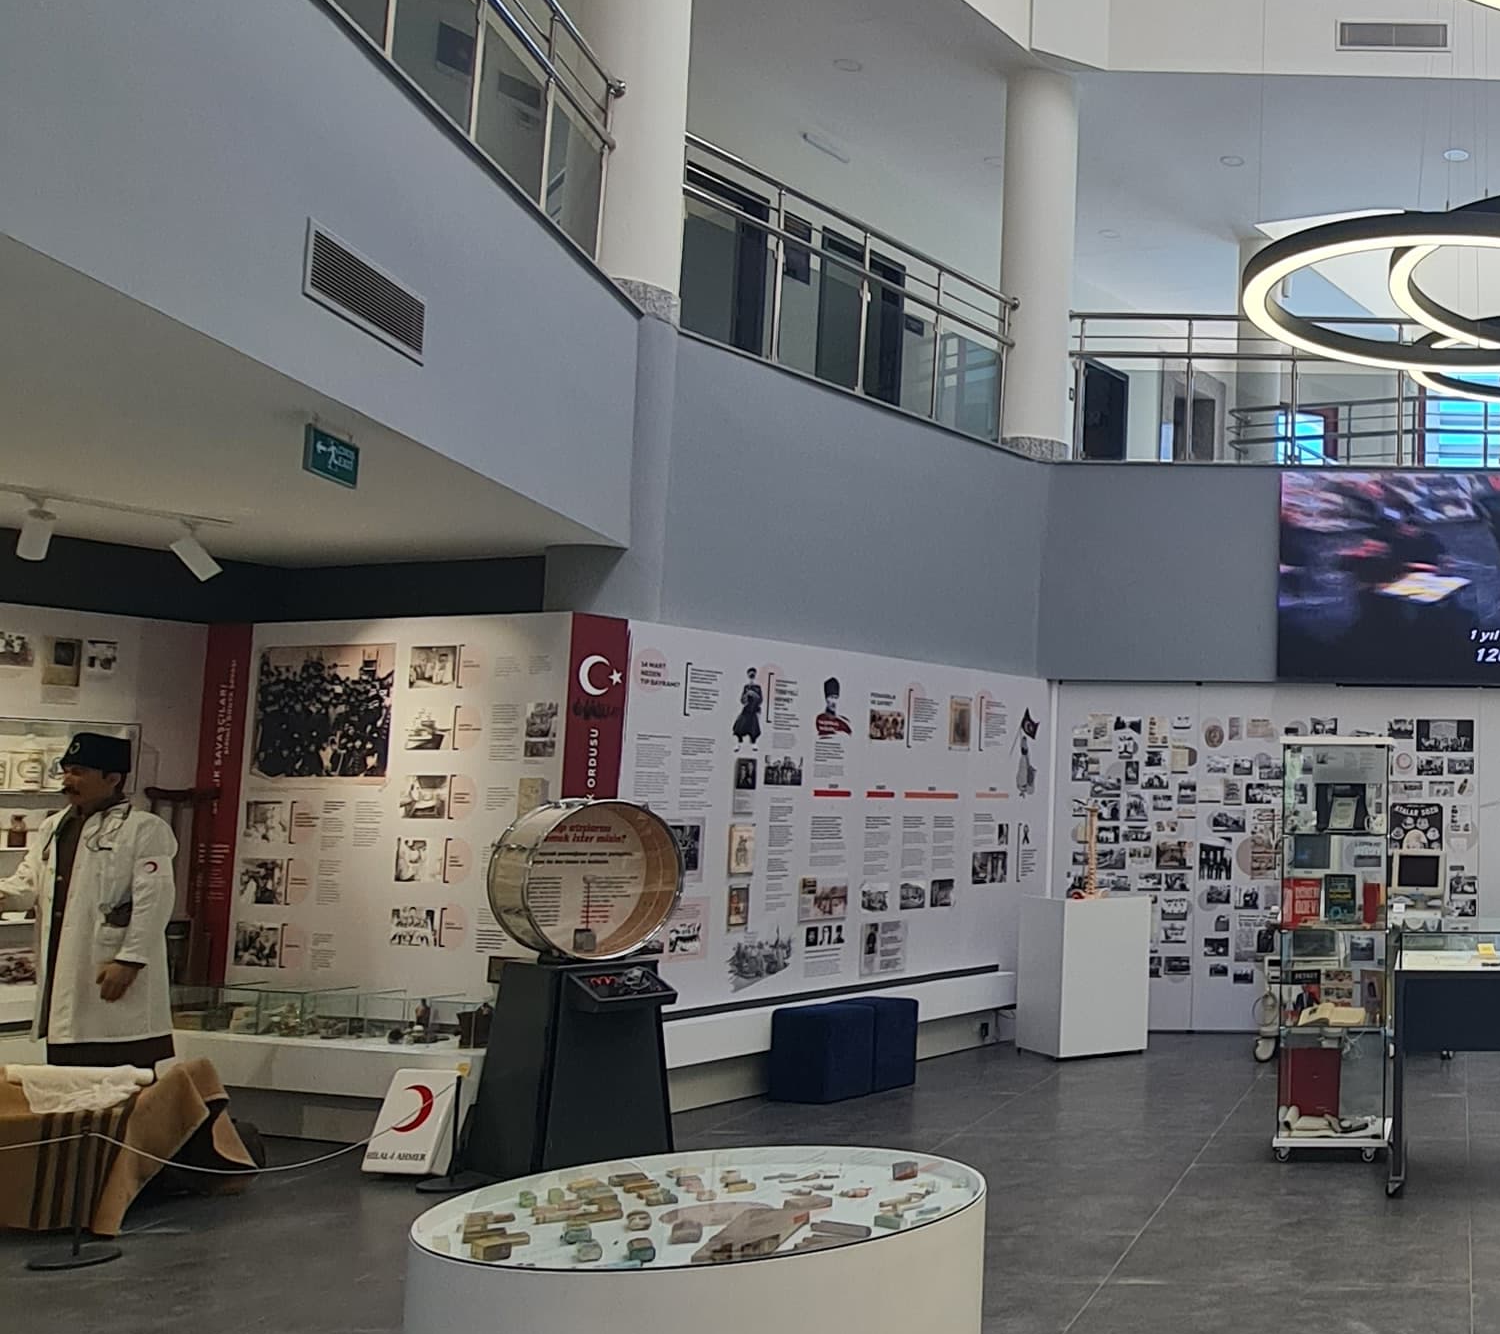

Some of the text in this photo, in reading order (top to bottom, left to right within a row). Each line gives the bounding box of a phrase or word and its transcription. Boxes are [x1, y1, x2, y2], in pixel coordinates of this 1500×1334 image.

[1470, 629, 1476, 641] 1
[1480, 629, 1499, 643] yıl
[587, 728, 599, 788] ORDUSU
